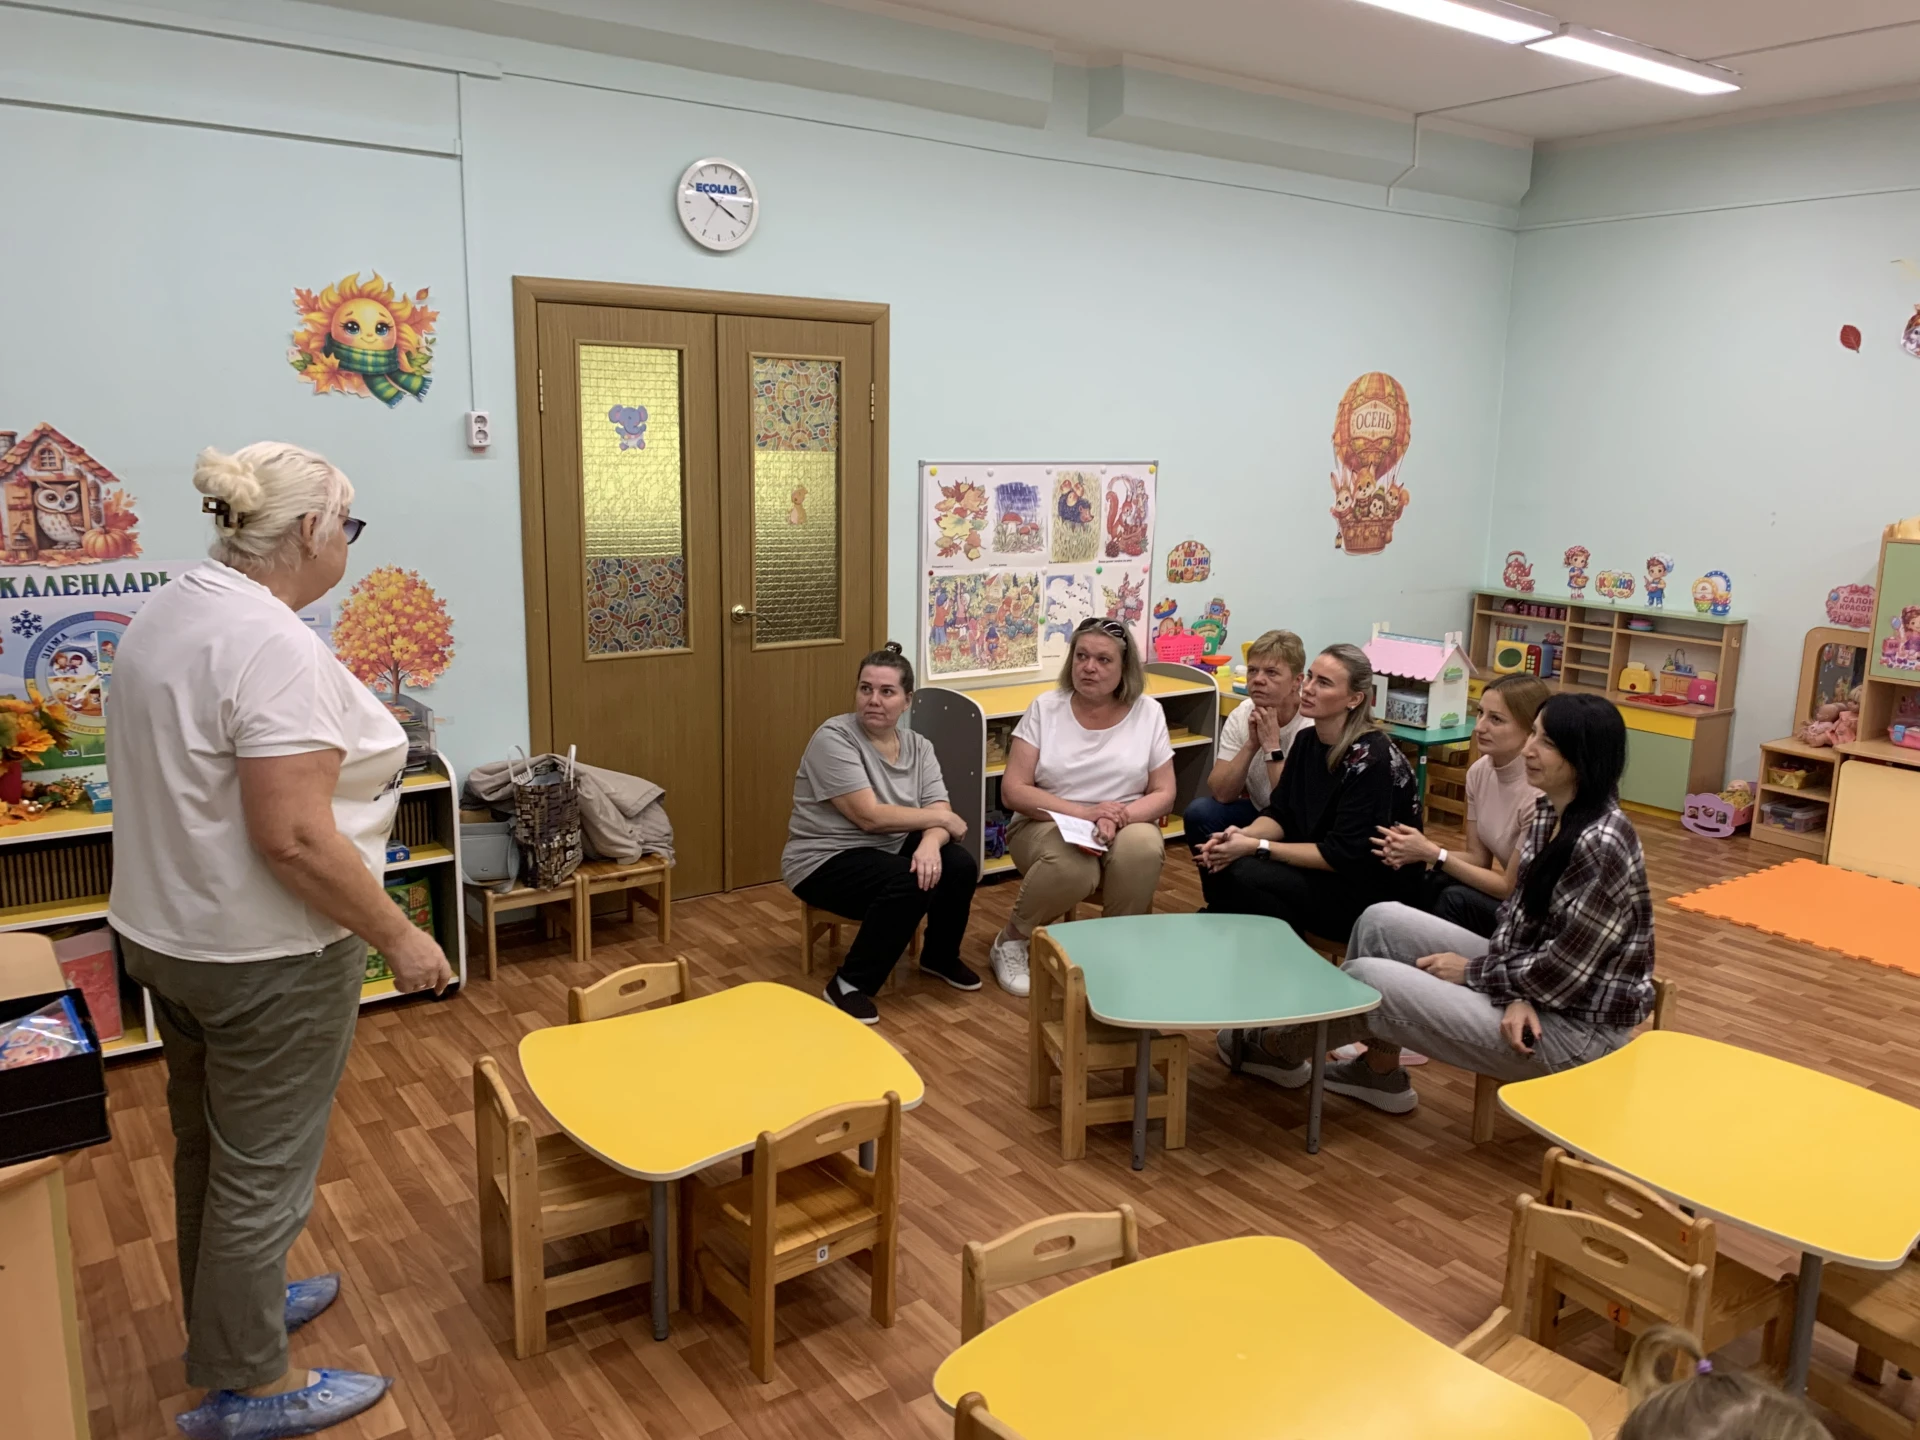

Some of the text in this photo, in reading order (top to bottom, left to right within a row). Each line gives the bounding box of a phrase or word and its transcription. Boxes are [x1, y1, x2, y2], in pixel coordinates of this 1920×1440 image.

[695, 182, 738, 195] ECOLAB
[1356, 411, 1392, 430] ОСЕНЬ
[1170, 557, 1209, 568] МАГАЗИН
[1598, 575, 1633, 590] КУХНЯ
[1613, 1307, 1621, 1323] 1
